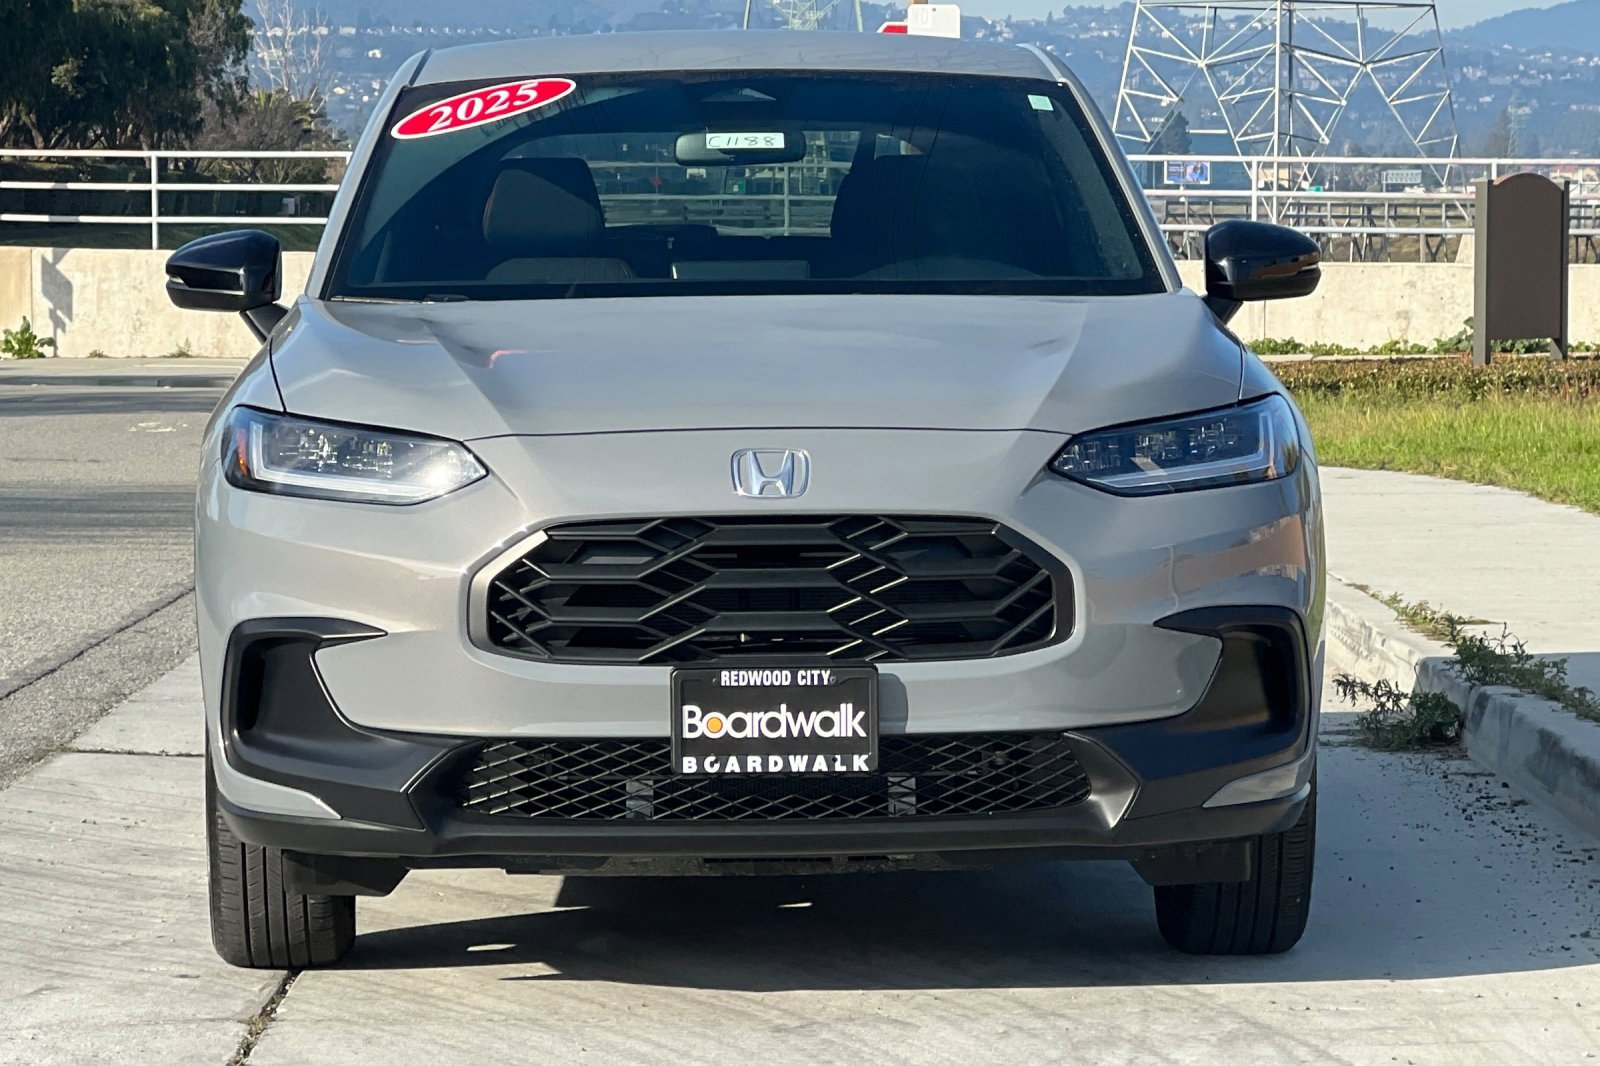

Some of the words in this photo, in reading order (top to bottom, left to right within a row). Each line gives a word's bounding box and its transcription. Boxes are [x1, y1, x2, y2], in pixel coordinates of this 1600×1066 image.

[427, 81, 540, 133] 2025
[708, 136, 777, 148] C1188
[720, 670, 791, 687] REDWOOD
[797, 669, 831, 686] CITY
[682, 702, 868, 739] Boardwalk
[682, 754, 870, 774] BOARDWALK
